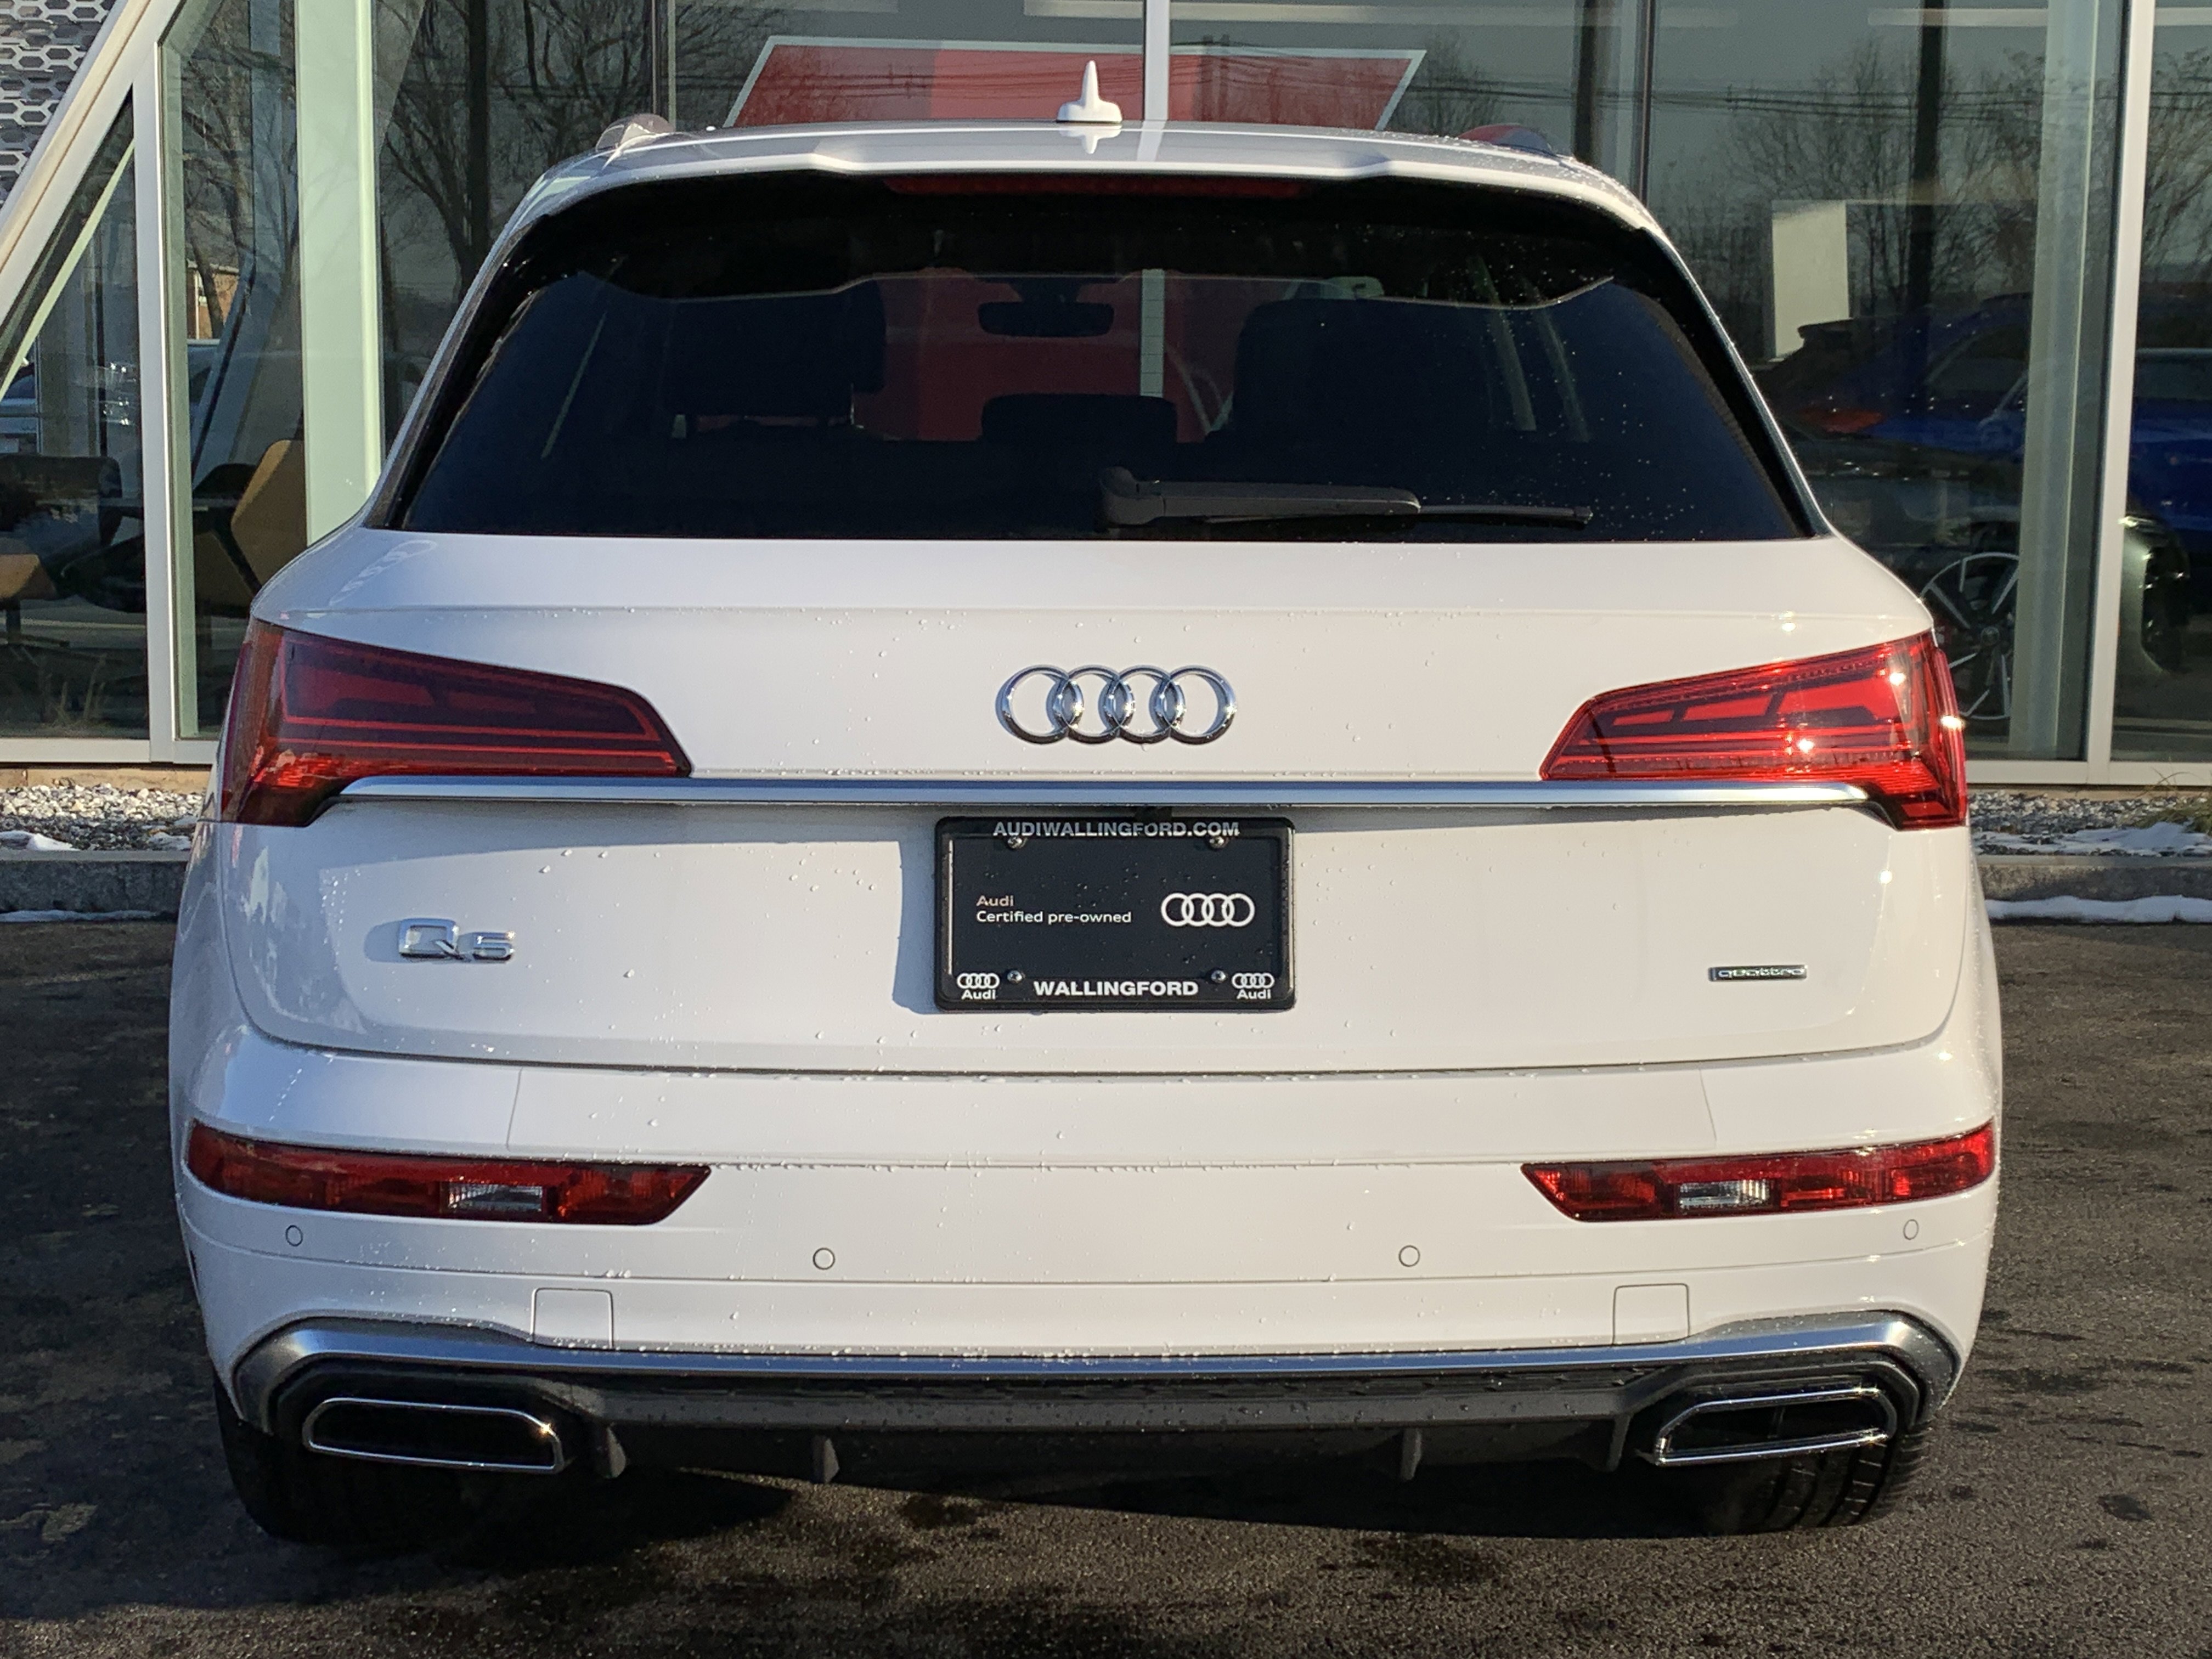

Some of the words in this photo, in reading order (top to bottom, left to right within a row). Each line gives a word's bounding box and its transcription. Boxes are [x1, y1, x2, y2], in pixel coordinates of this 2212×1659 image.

[993, 822, 1239, 837] AUDIWALLINGFORD.COM
[976, 895, 1014, 907] Audi
[976, 910, 1043, 923] Certified
[1047, 911, 1132, 925] pre-owned
[398, 918, 515, 961] Q5
[961, 989, 996, 1000] Audi
[1034, 981, 1199, 996] WALLINGFORD
[1237, 989, 1272, 1000] Audi
